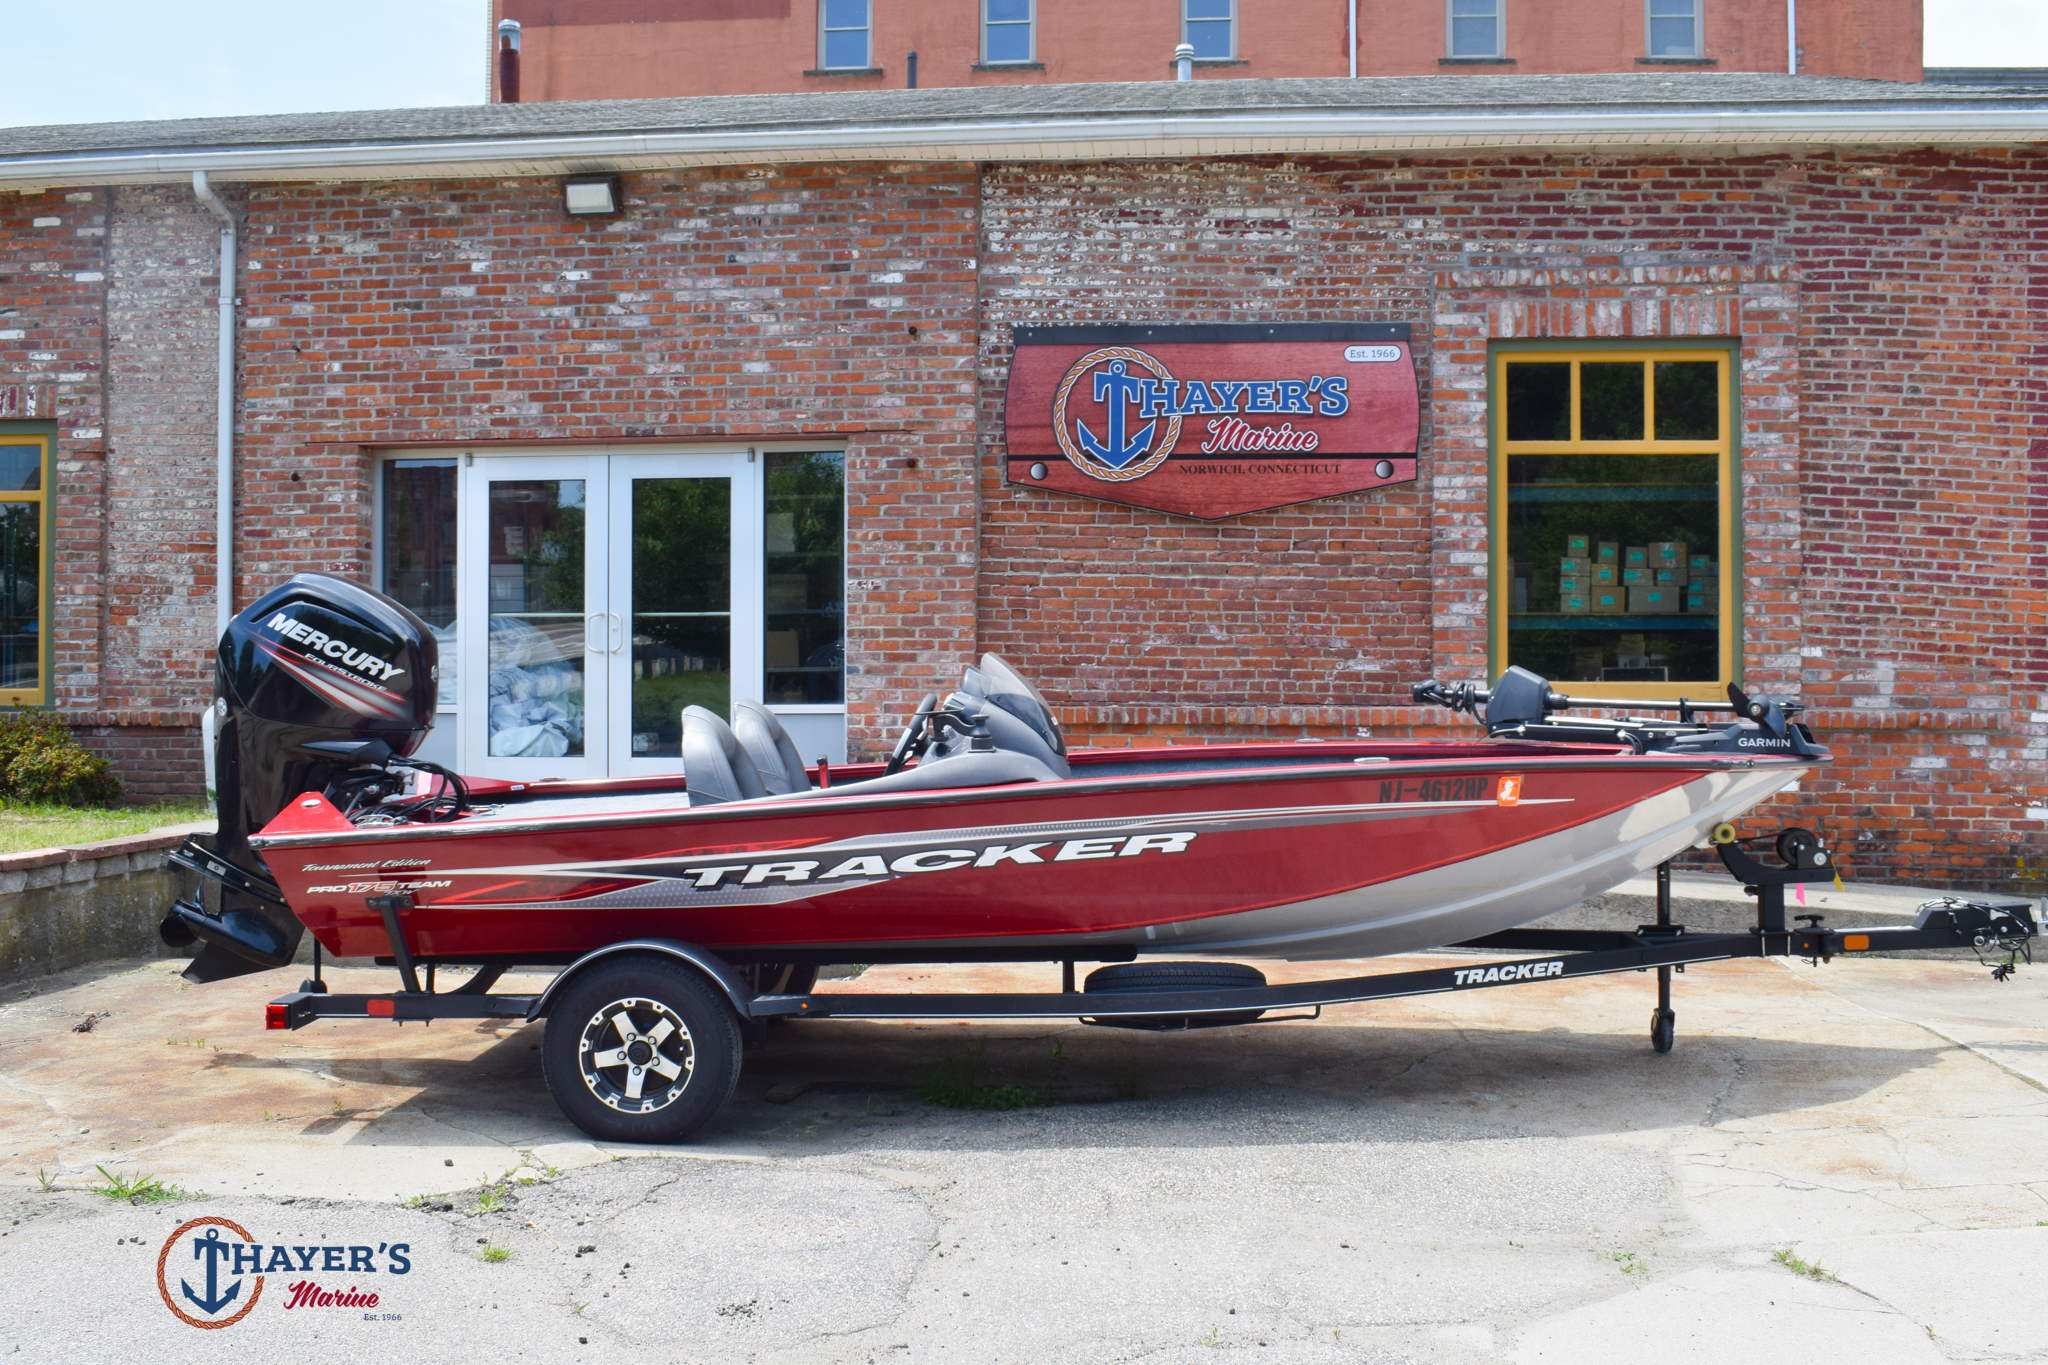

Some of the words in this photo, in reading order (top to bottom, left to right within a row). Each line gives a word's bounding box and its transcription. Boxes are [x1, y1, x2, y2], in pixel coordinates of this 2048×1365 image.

[1349, 348, 1367, 359] Est.
[1370, 348, 1396, 359] 1966
[1201, 416, 1319, 454] Marine
[1179, 464, 1245, 476] NORWICH,
[1249, 463, 1342, 475] CONNECTICUT
[267, 612, 405, 682] MERCURY
[303, 653, 388, 693] FOURSTROKE
[1738, 737, 1791, 748] GARMIN
[1379, 777, 1489, 803] NJ-4612HP
[302, 860, 381, 872] Tournament
[381, 858, 432, 868] Edition
[682, 831, 1198, 888] TRACKER
[306, 884, 348, 894] PRO
[347, 880, 398, 893] 175
[398, 880, 452, 889] TEAM
[1454, 961, 1564, 985] TRACKER
